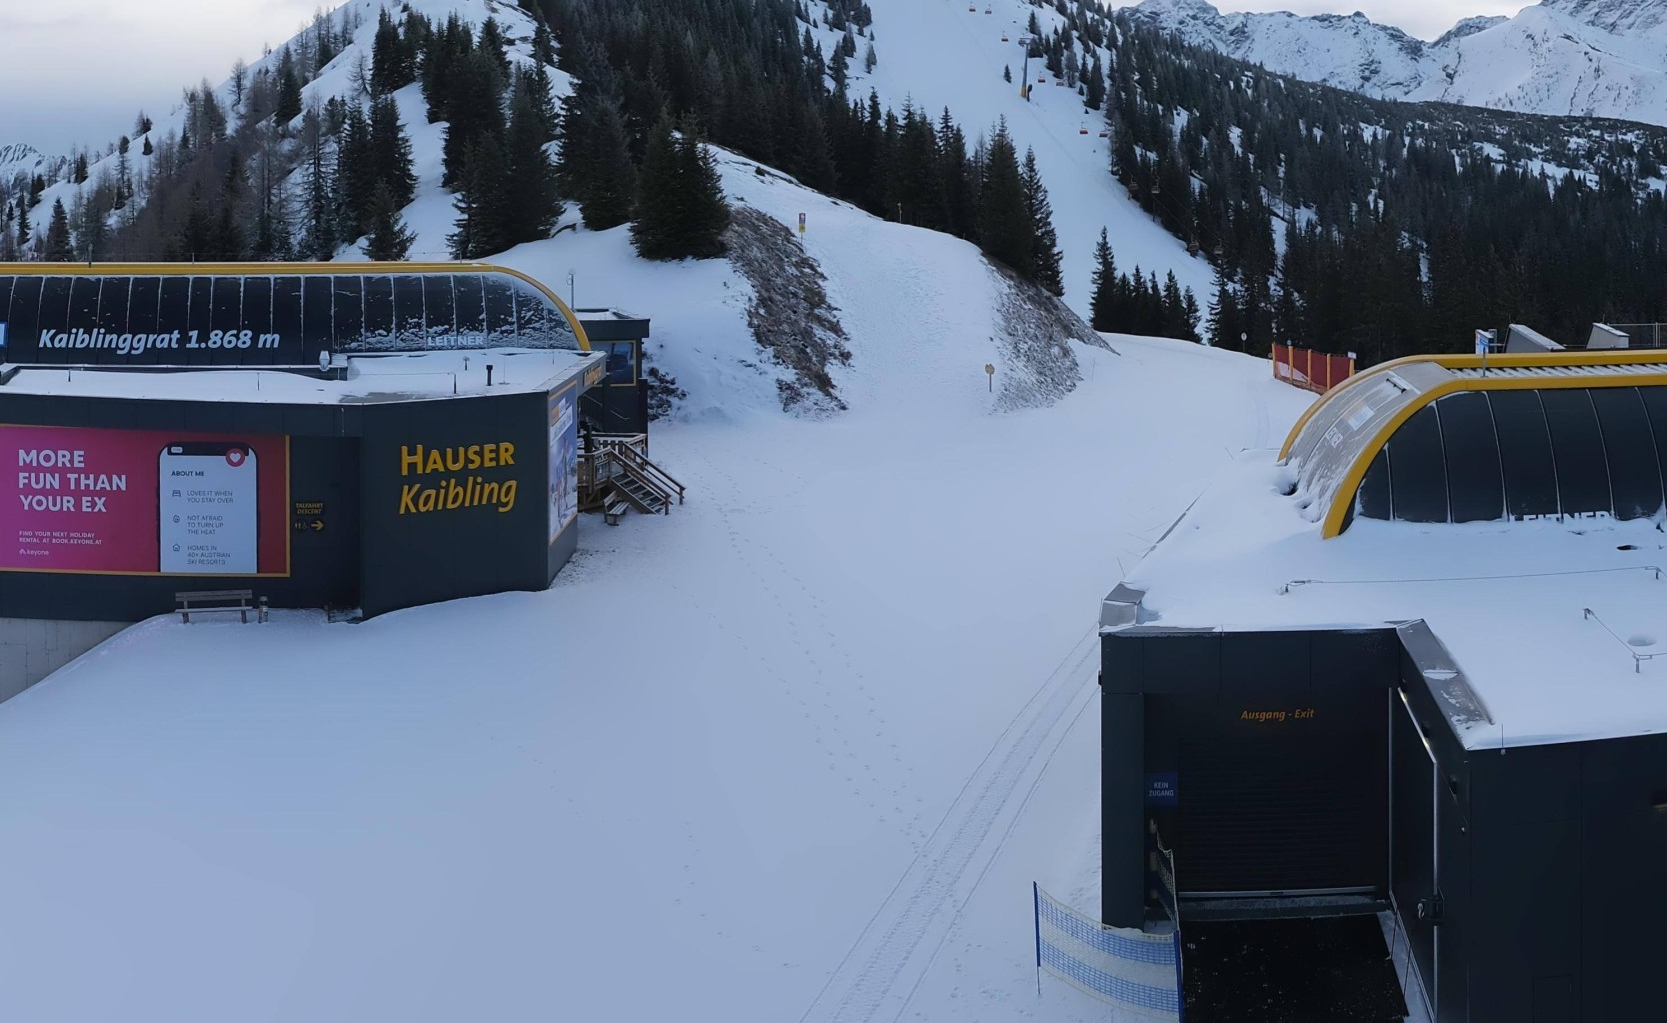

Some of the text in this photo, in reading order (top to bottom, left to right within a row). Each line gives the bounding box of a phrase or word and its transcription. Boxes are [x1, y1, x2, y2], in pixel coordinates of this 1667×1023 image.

[38, 328, 280, 354] Kaiblinggrat 1.868 m
[428, 335, 485, 346] LEITNER
[18, 449, 85, 468] MORE
[400, 441, 516, 476] HAUSER
[18, 472, 127, 491] FUN THAN
[19, 495, 107, 512] YOUR EX
[399, 475, 518, 515] Kaibling
[1240, 710, 1286, 721] Ausgang
[1294, 708, 1316, 719] Exit
[1148, 789, 1174, 797] ZUGANG
[1153, 781, 1169, 789] KEIN
